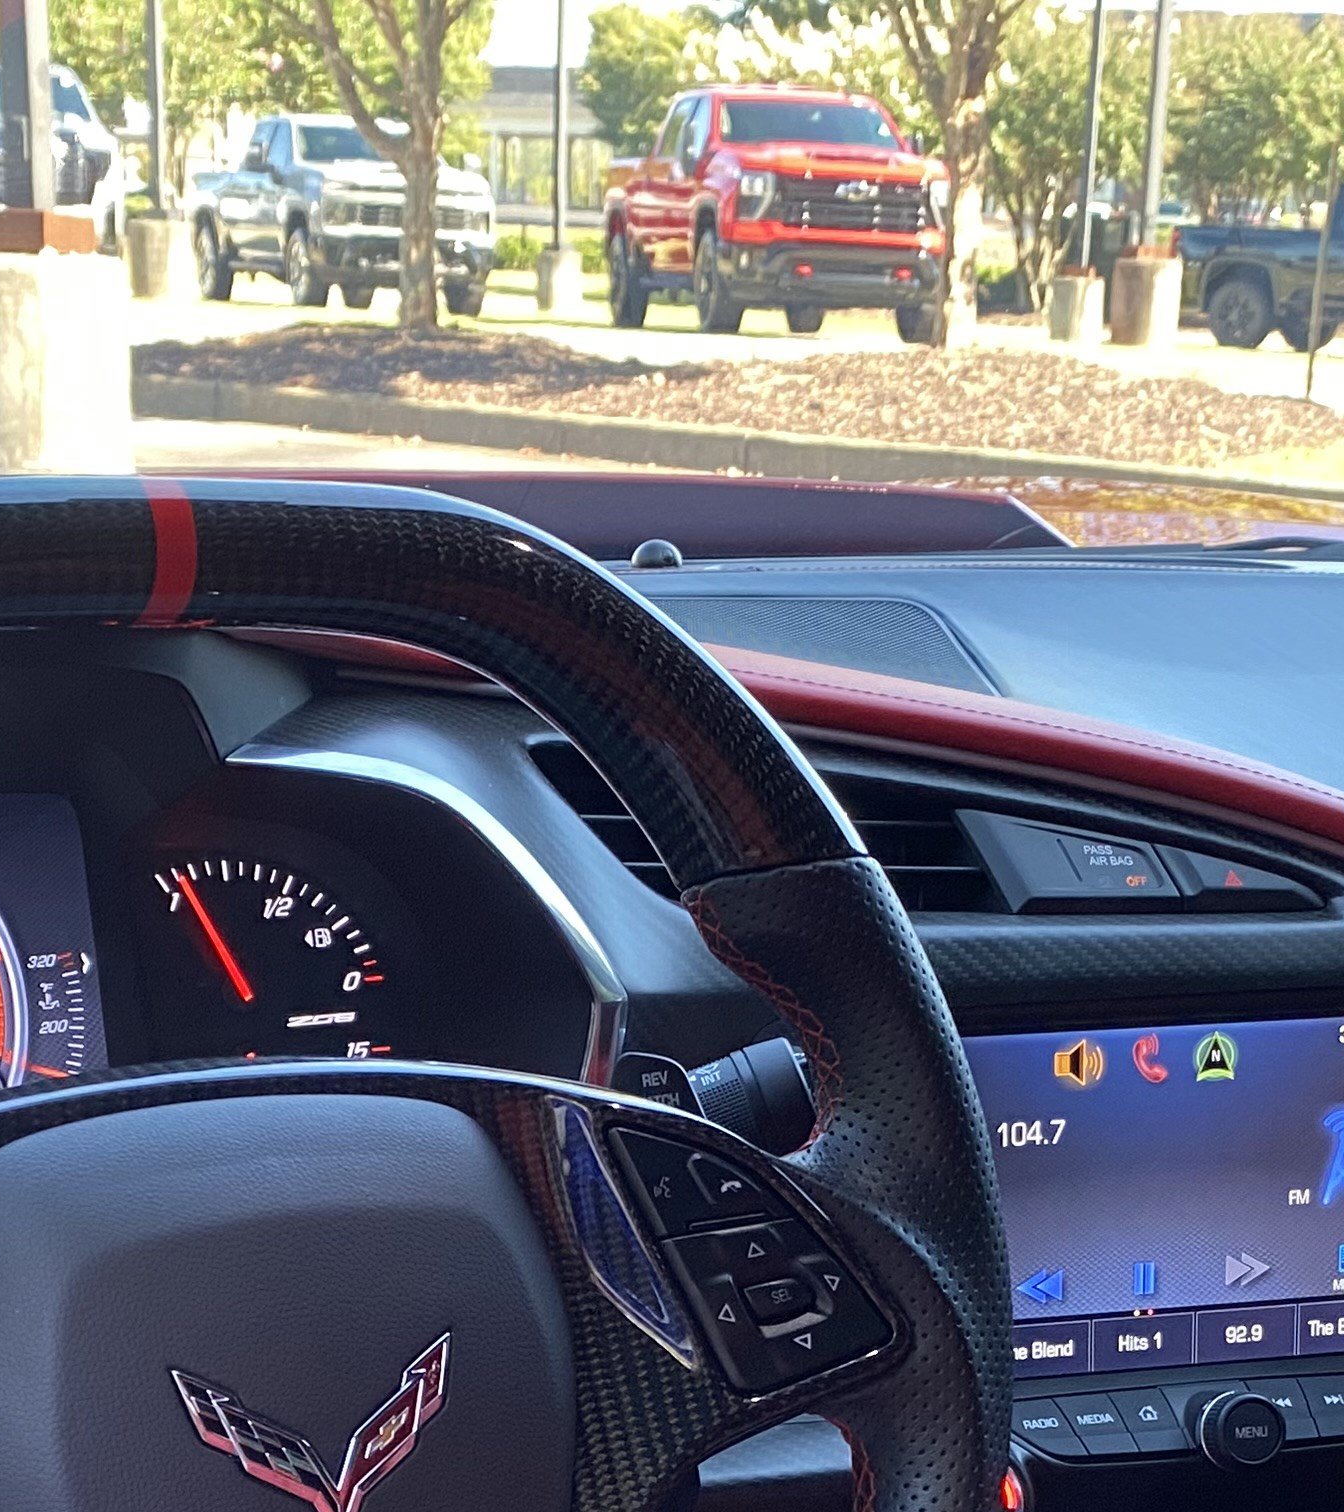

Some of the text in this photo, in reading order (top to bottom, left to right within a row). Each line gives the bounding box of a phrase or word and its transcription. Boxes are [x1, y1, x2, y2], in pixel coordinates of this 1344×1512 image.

[1083, 845, 1113, 856] PASS
[1089, 855, 1133, 867] AIR BAG
[1126, 876, 1147, 887] OFF
[170, 892, 180, 912] 1
[263, 897, 293, 919] 1/2
[27, 954, 57, 969] 320
[343, 971, 362, 991] 0
[38, 1019, 69, 1035] 200
[346, 1041, 371, 1059] 15
[641, 1070, 668, 1088] REV
[700, 1070, 721, 1087] INT
[996, 1119, 1066, 1148] 104.7
[1287, 1189, 1310, 1206] FM
[770, 1287, 792, 1305] SEL
[1224, 1324, 1264, 1345] 92.9
[1307, 1319, 1334, 1337] The
[1031, 1339, 1074, 1360] Blend
[1117, 1332, 1163, 1353] Hits 1
[1022, 1417, 1059, 1430] RADIO
[1076, 1412, 1115, 1425] MEDIA
[1234, 1423, 1269, 1440] MENU
